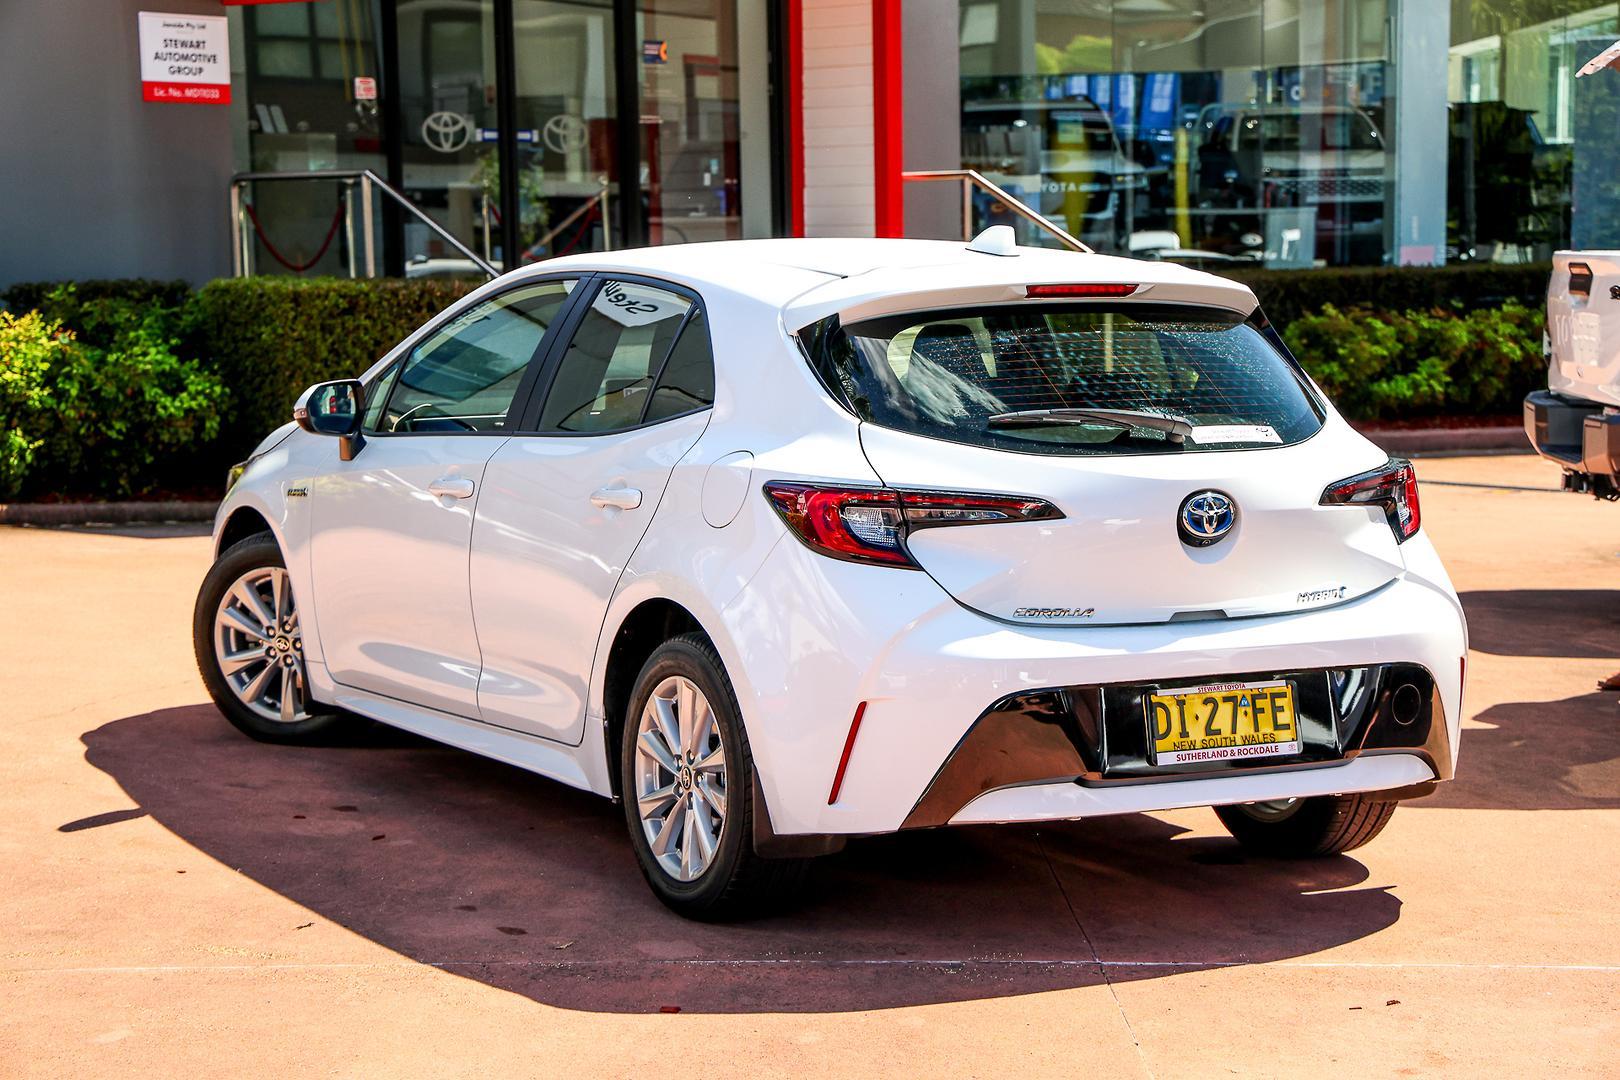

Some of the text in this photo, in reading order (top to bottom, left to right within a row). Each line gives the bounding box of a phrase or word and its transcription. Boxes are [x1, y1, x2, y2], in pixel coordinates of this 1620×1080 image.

[163, 39, 206, 49] STEWART
[154, 51, 217, 64] AUTOMOTIVE
[168, 65, 204, 76] GROUP
[1013, 607, 1095, 619] COROLLA
[1197, 683, 1246, 693] STEWART TOYOTA
[1173, 733, 1276, 750] NEW SOUTH WALES
[1176, 750, 1229, 762] SUTHERLAND
[1237, 745, 1279, 756] ROCKDALE
